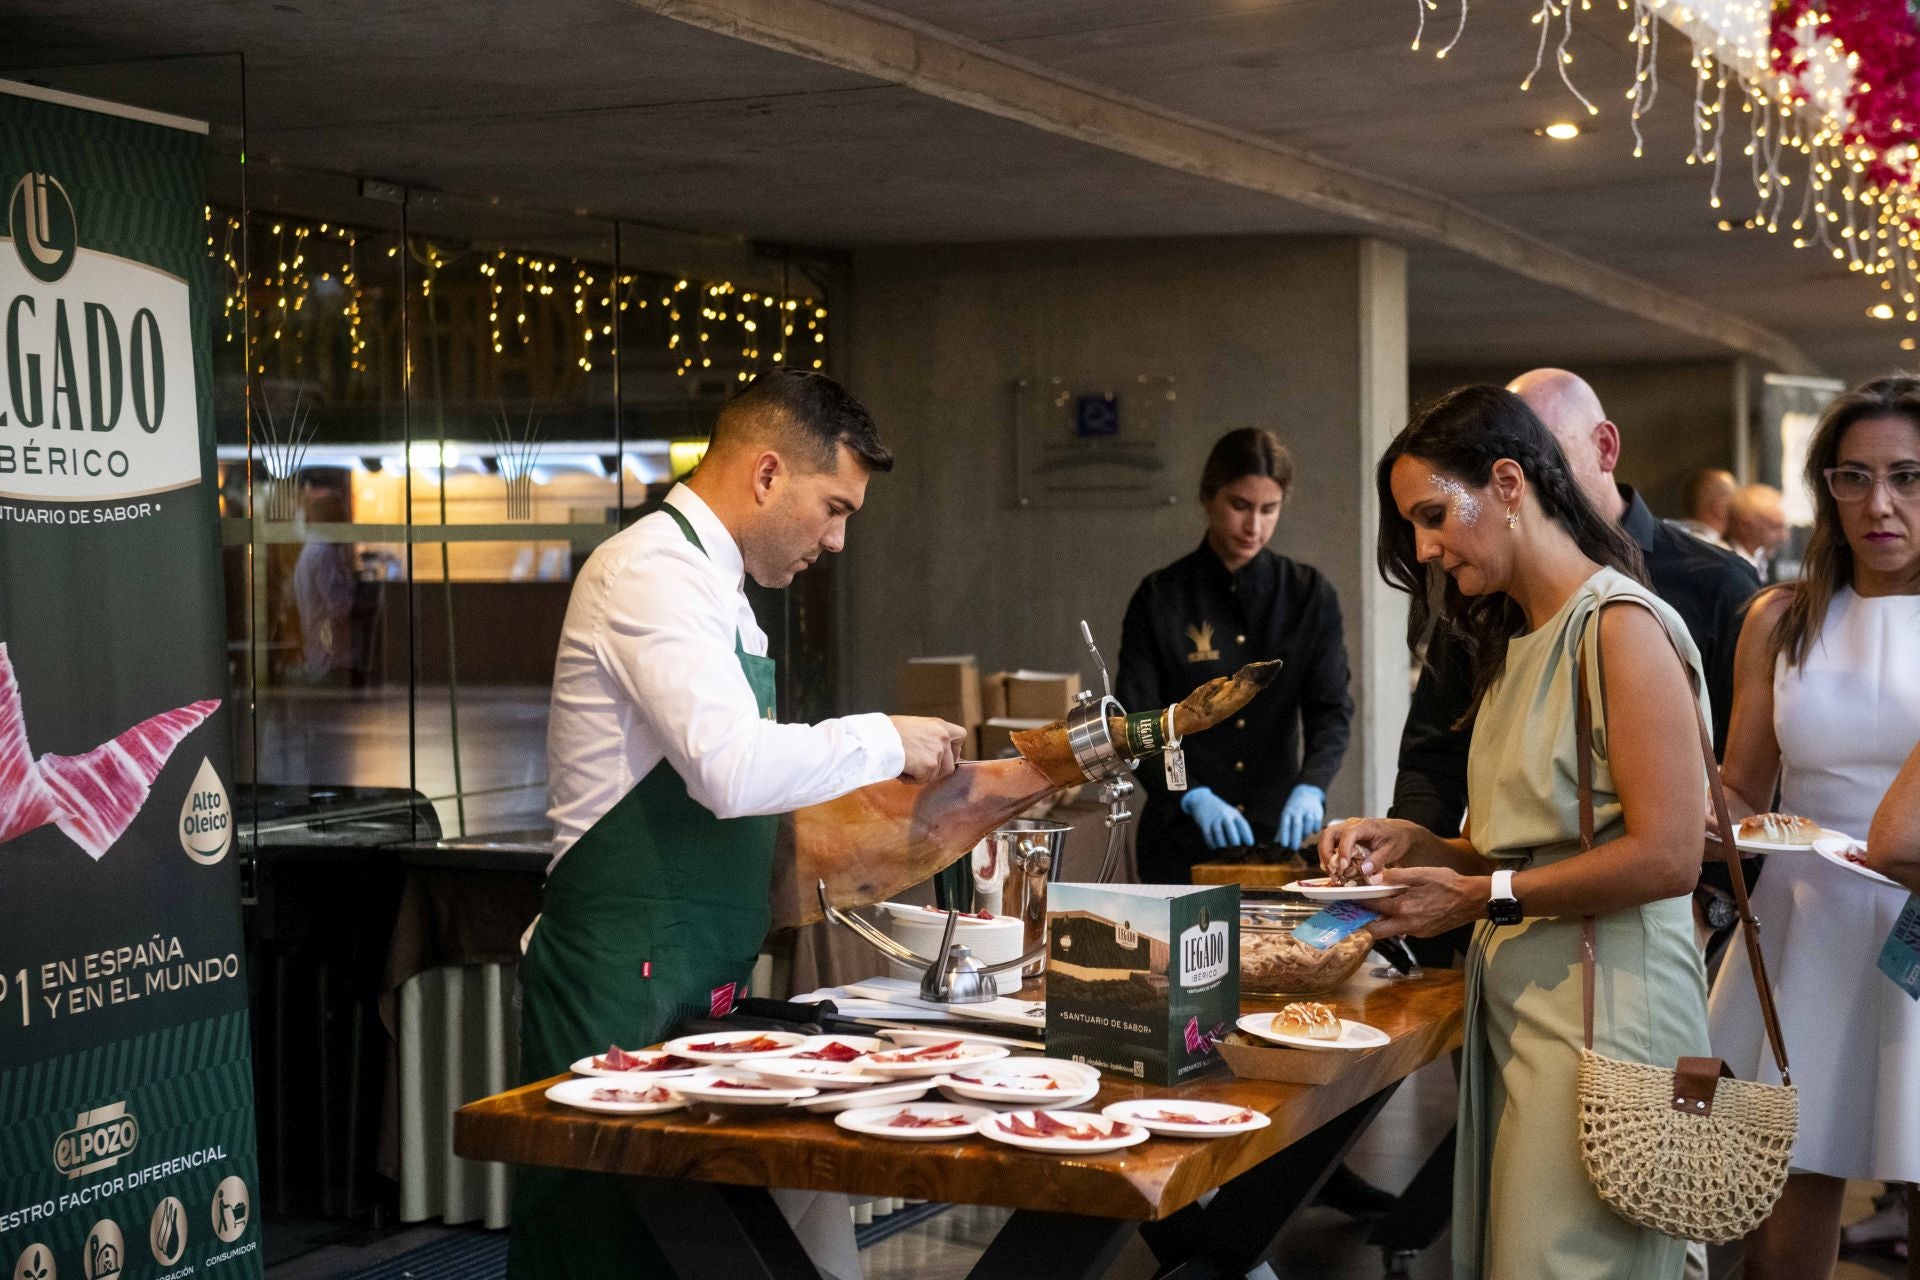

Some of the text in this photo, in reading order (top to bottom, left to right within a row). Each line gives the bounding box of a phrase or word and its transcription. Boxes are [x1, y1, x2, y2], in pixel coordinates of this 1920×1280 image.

[0, 293, 165, 434] GADO
[0, 503, 151, 525] TUARIO DE SABOR
[1140, 718, 1156, 749] LEGADO
[192, 791, 221, 813] Alto
[41, 933, 185, 989] EN ESPAÑA
[1185, 931, 1224, 973] LEGADO
[43, 953, 239, 1019] Y EN EL MUNDO
[1110, 1019, 1122, 1029] DE
[59, 1177, 124, 1212] FACTOR
[128, 1145, 227, 1189] DIFERENCIAL
[205, 1241, 257, 1267] CONSUMIDOR
